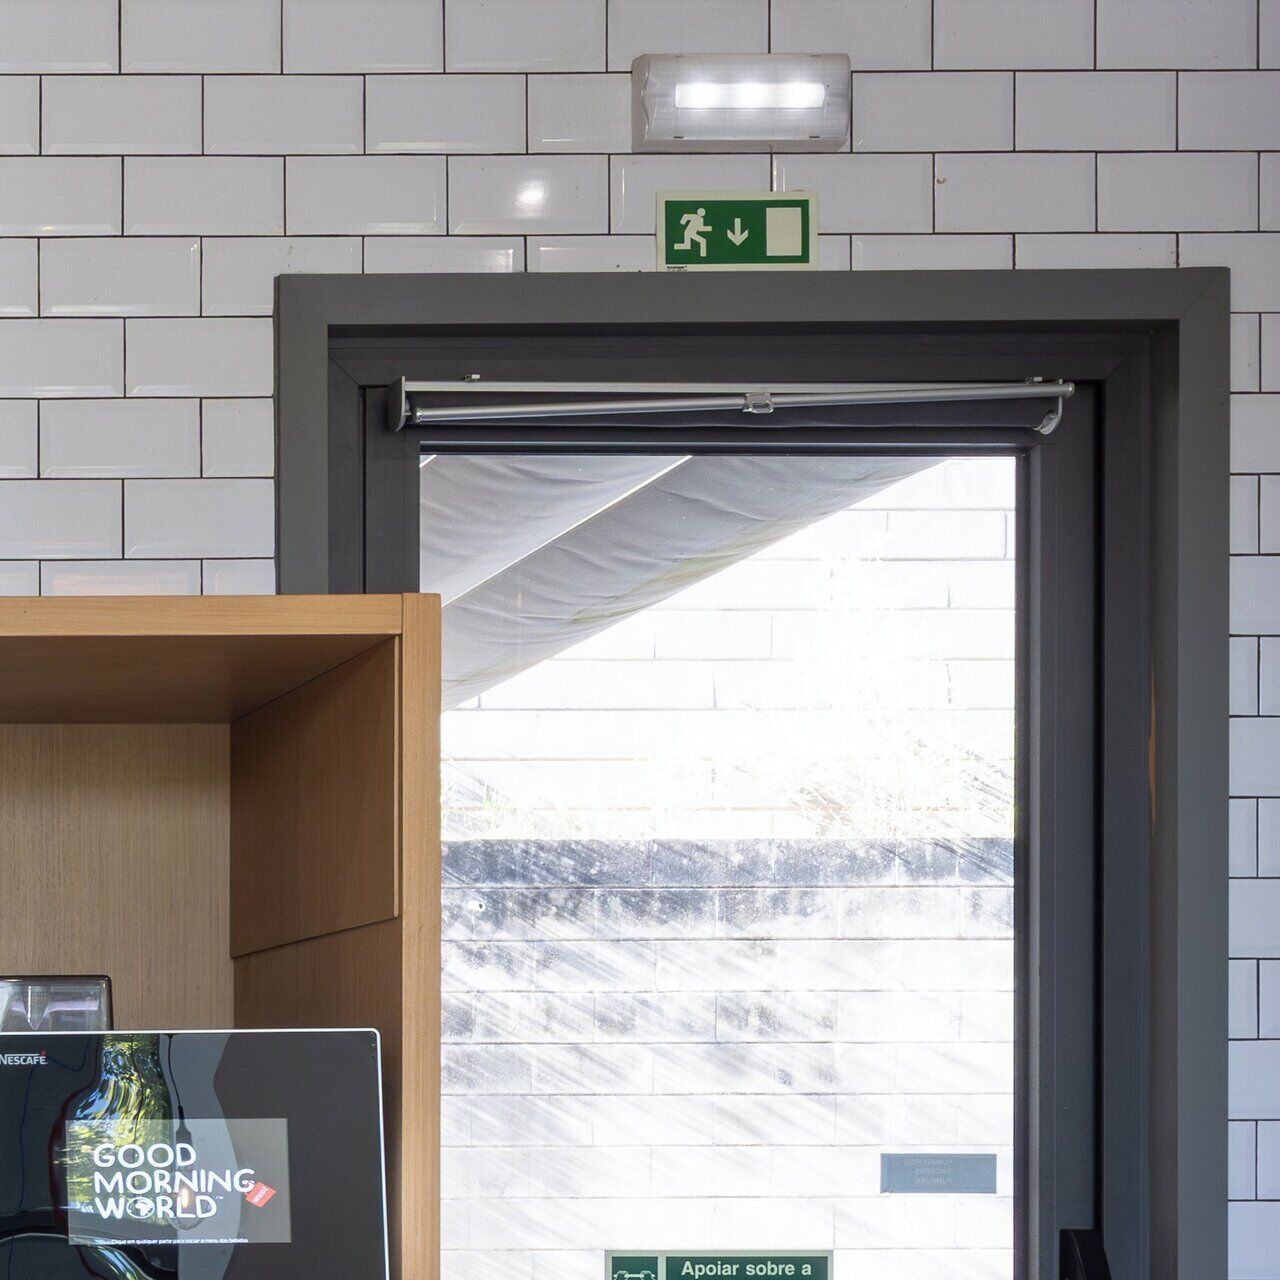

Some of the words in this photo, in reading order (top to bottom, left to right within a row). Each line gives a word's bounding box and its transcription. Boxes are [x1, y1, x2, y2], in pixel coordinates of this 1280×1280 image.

[93, 1143, 197, 1168] GOOD
[93, 1169, 255, 1194] MORNING
[682, 1261, 739, 1279] Apoiar
[746, 1261, 795, 1275] sobre
[802, 1264, 811, 1275] a
